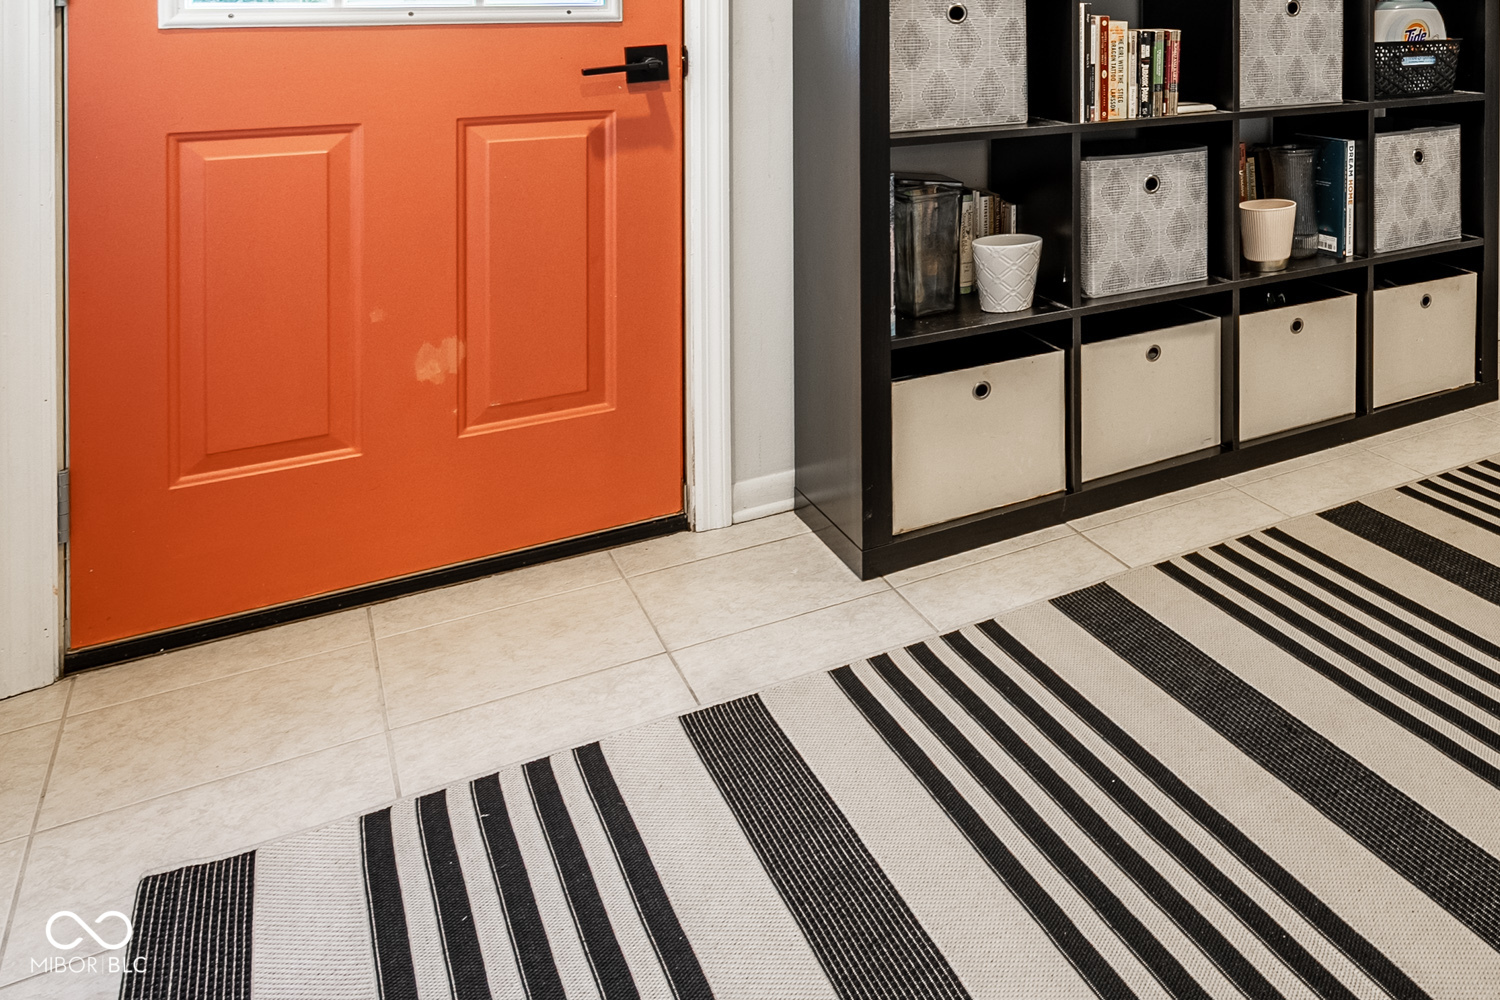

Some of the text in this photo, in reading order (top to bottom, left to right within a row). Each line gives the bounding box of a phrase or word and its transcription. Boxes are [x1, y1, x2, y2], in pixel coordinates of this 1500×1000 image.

[1405, 28, 1427, 42] Tide
[1141, 63, 1149, 87] JURASSIC
[1141, 87, 1149, 103] PARK
